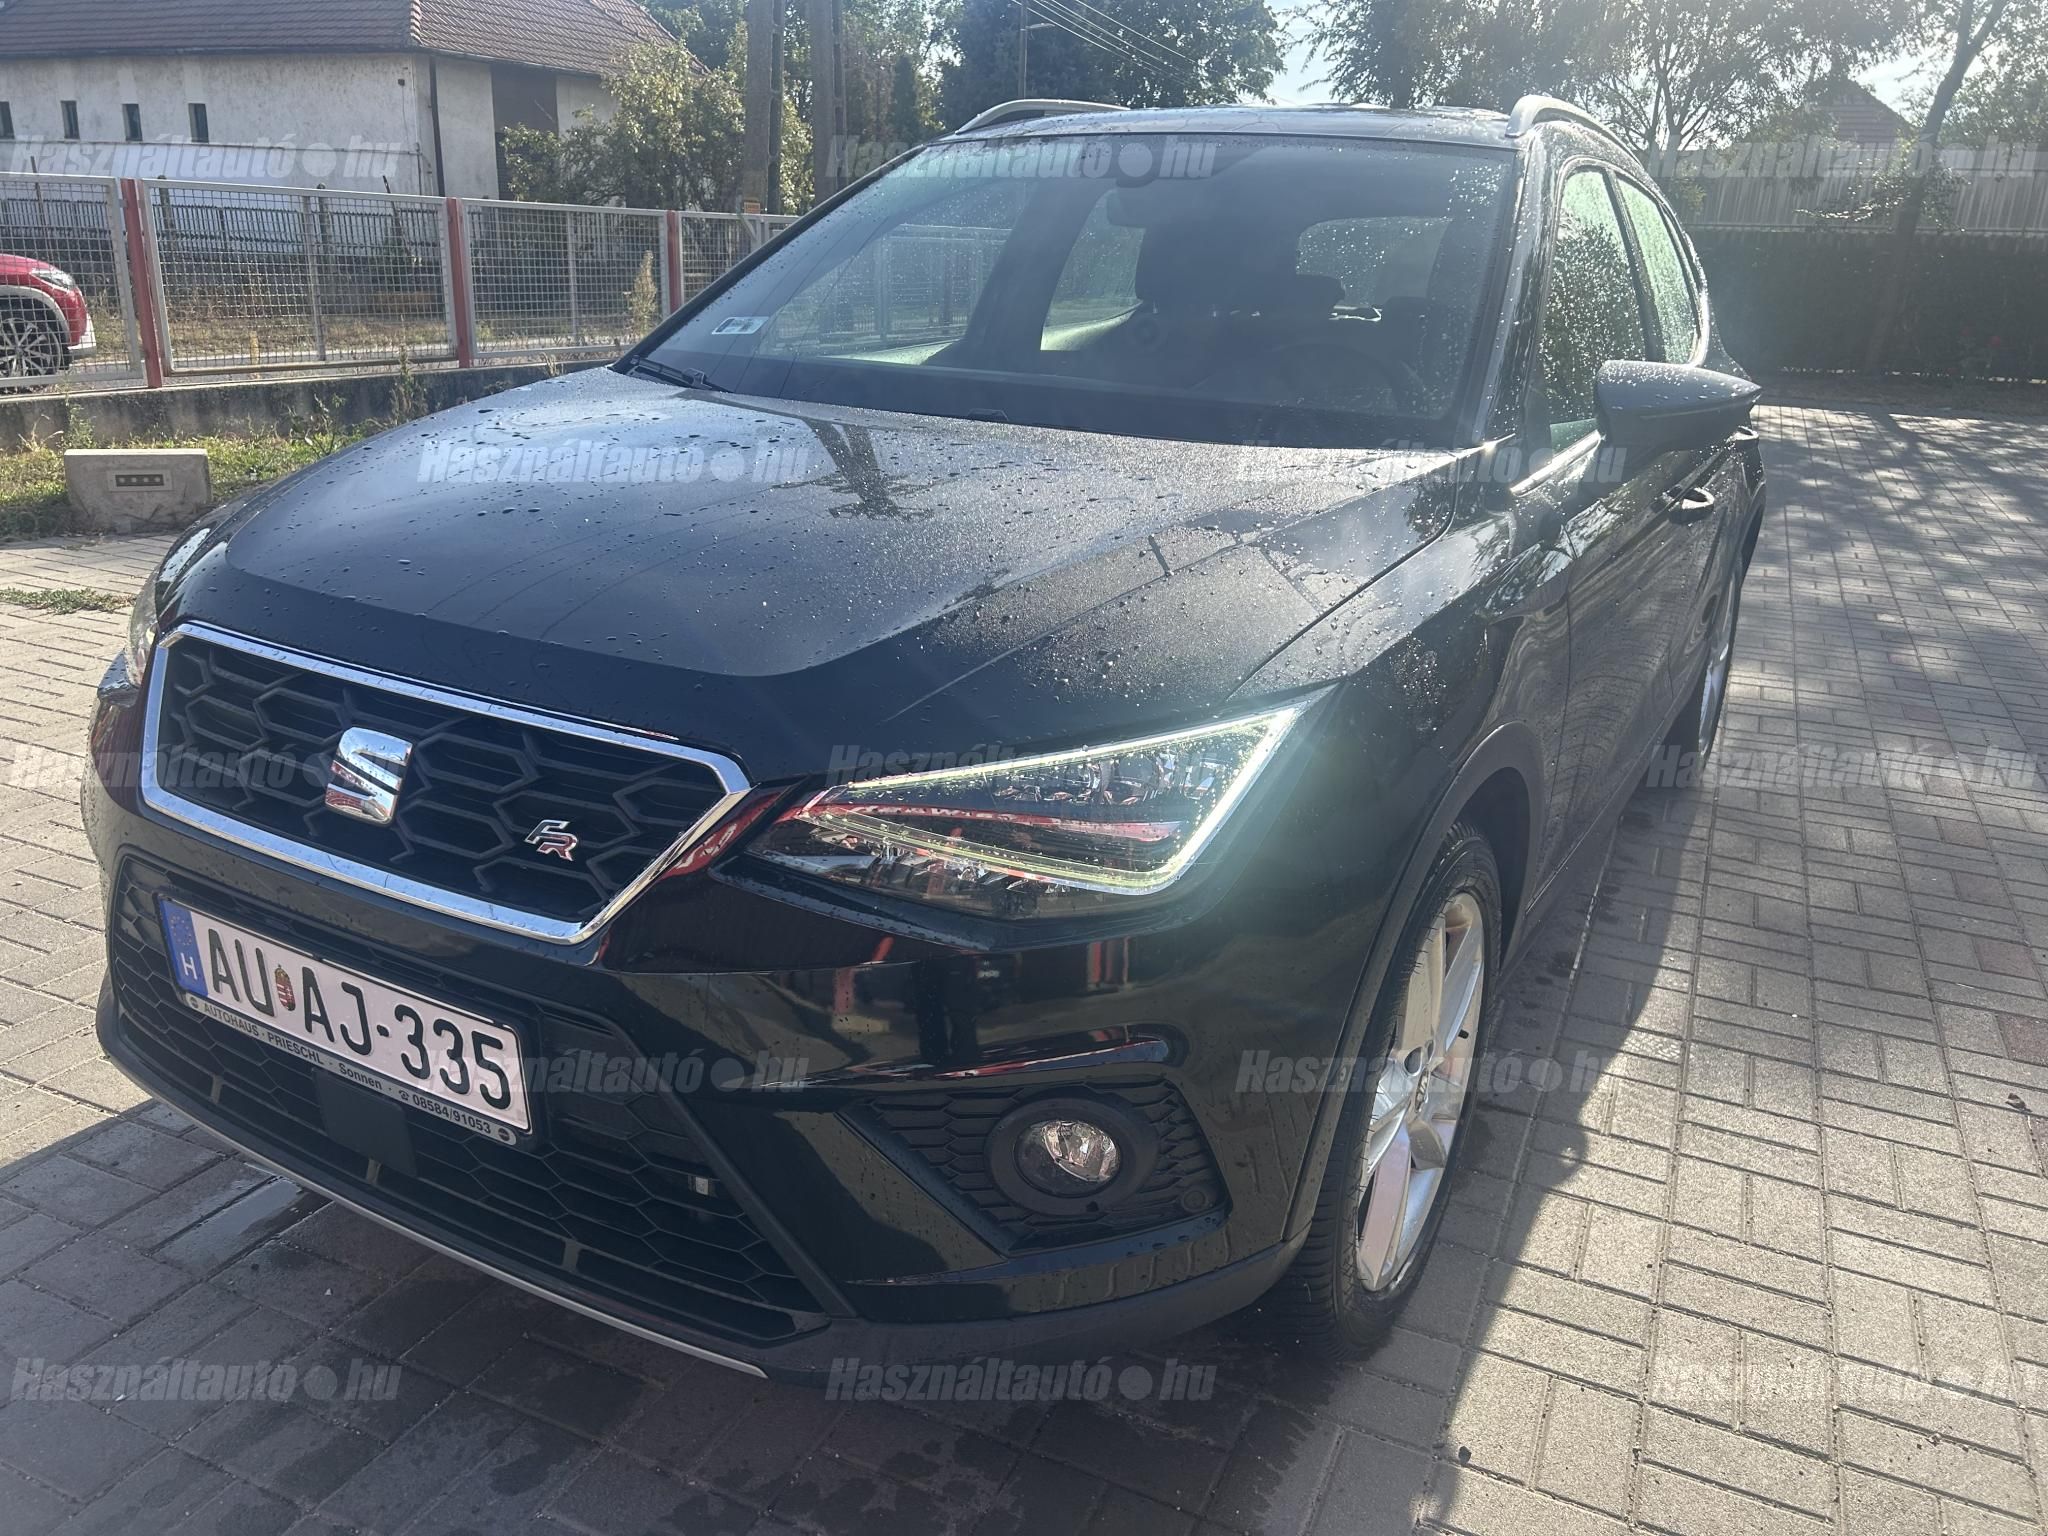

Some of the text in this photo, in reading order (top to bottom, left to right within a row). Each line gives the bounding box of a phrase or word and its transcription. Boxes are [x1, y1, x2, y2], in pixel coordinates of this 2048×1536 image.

[181, 951, 197, 982] H
[207, 928, 511, 1111] AU AJ-335
[204, 1002, 491, 1135] AUTOHAUS PRIESCHL Sonnen 08584/91053
